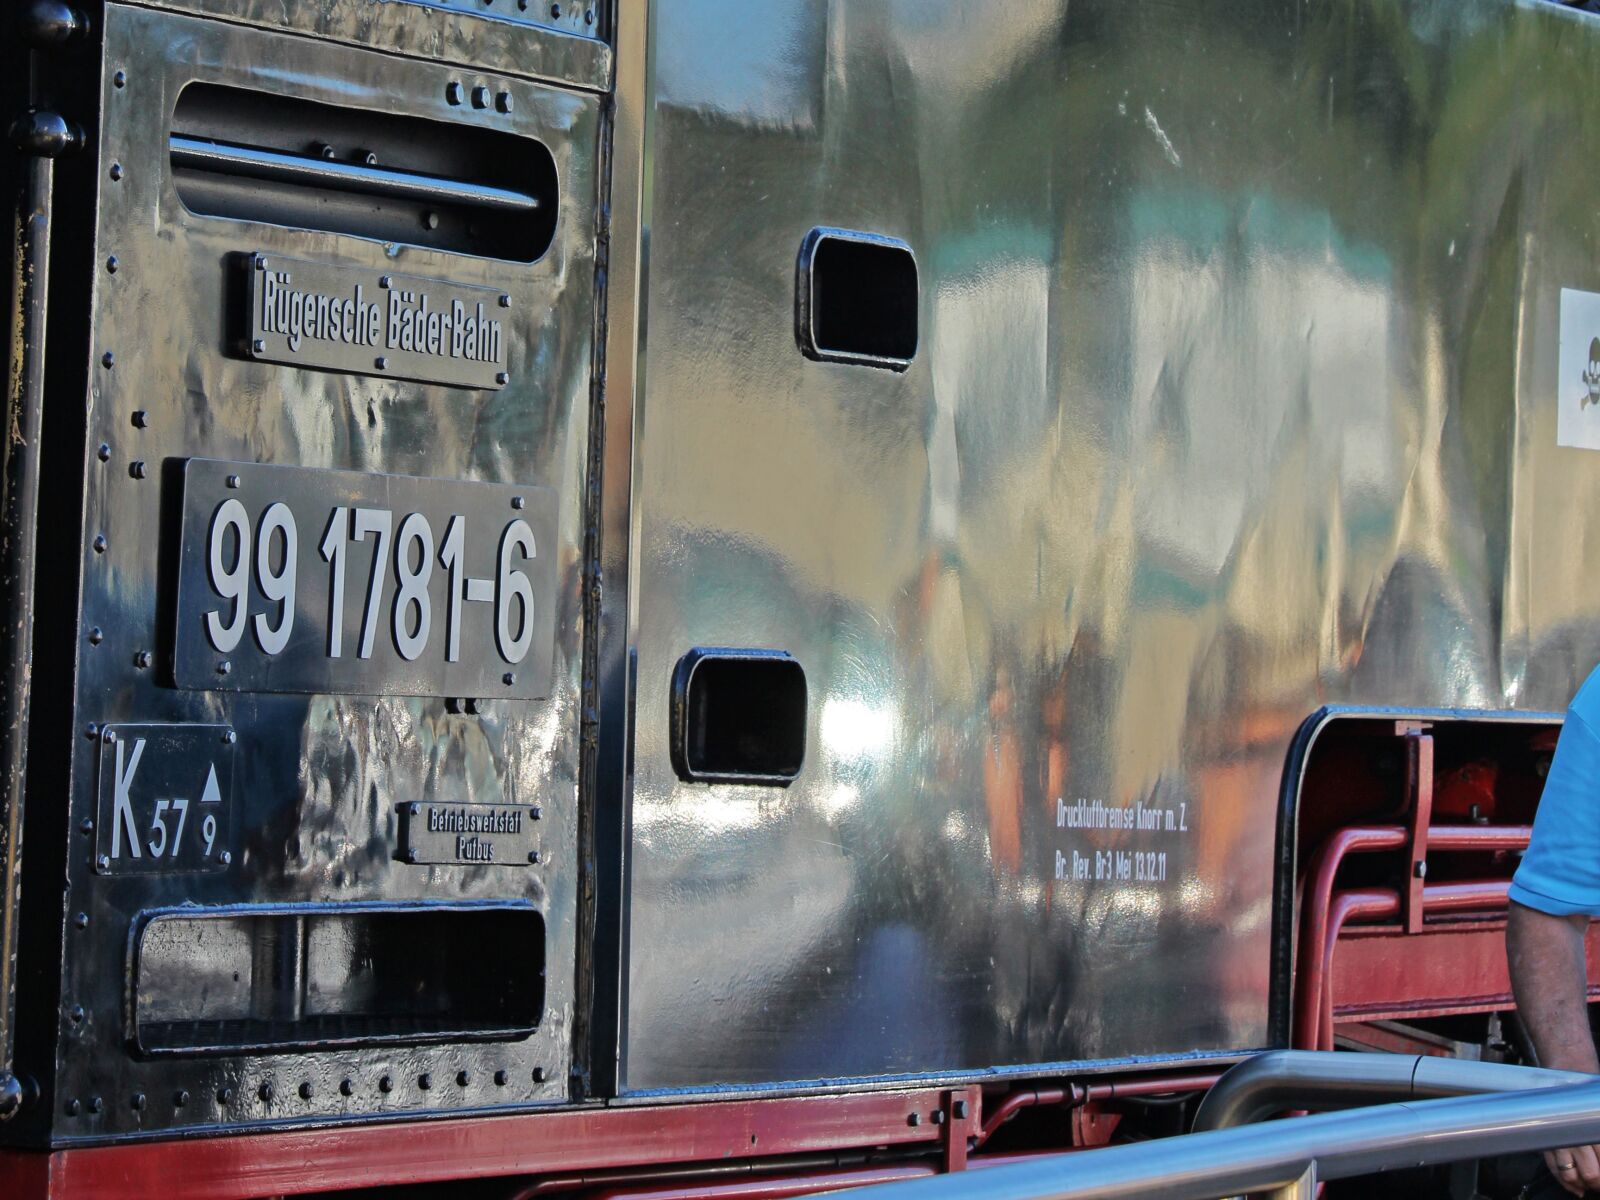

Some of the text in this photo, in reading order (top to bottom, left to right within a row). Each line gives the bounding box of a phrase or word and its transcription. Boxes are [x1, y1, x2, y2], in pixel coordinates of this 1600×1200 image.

[262, 270, 501, 363] Rügensche BäderBahn
[206, 498, 536, 664] 99 1781-6
[429, 808, 523, 833] Betriebswerkstatt
[1056, 797, 1134, 829] Druckluftbremse
[1136, 800, 1163, 831] Knorr
[1165, 809, 1177, 831] m.
[202, 814, 216, 857] 9
[457, 836, 495, 860] Putbus
[1055, 849, 1069, 880] Br.
[1072, 849, 1092, 880] Rev.
[1115, 850, 1132, 881] Mei
[1135, 850, 1167, 881] 13.12.11
